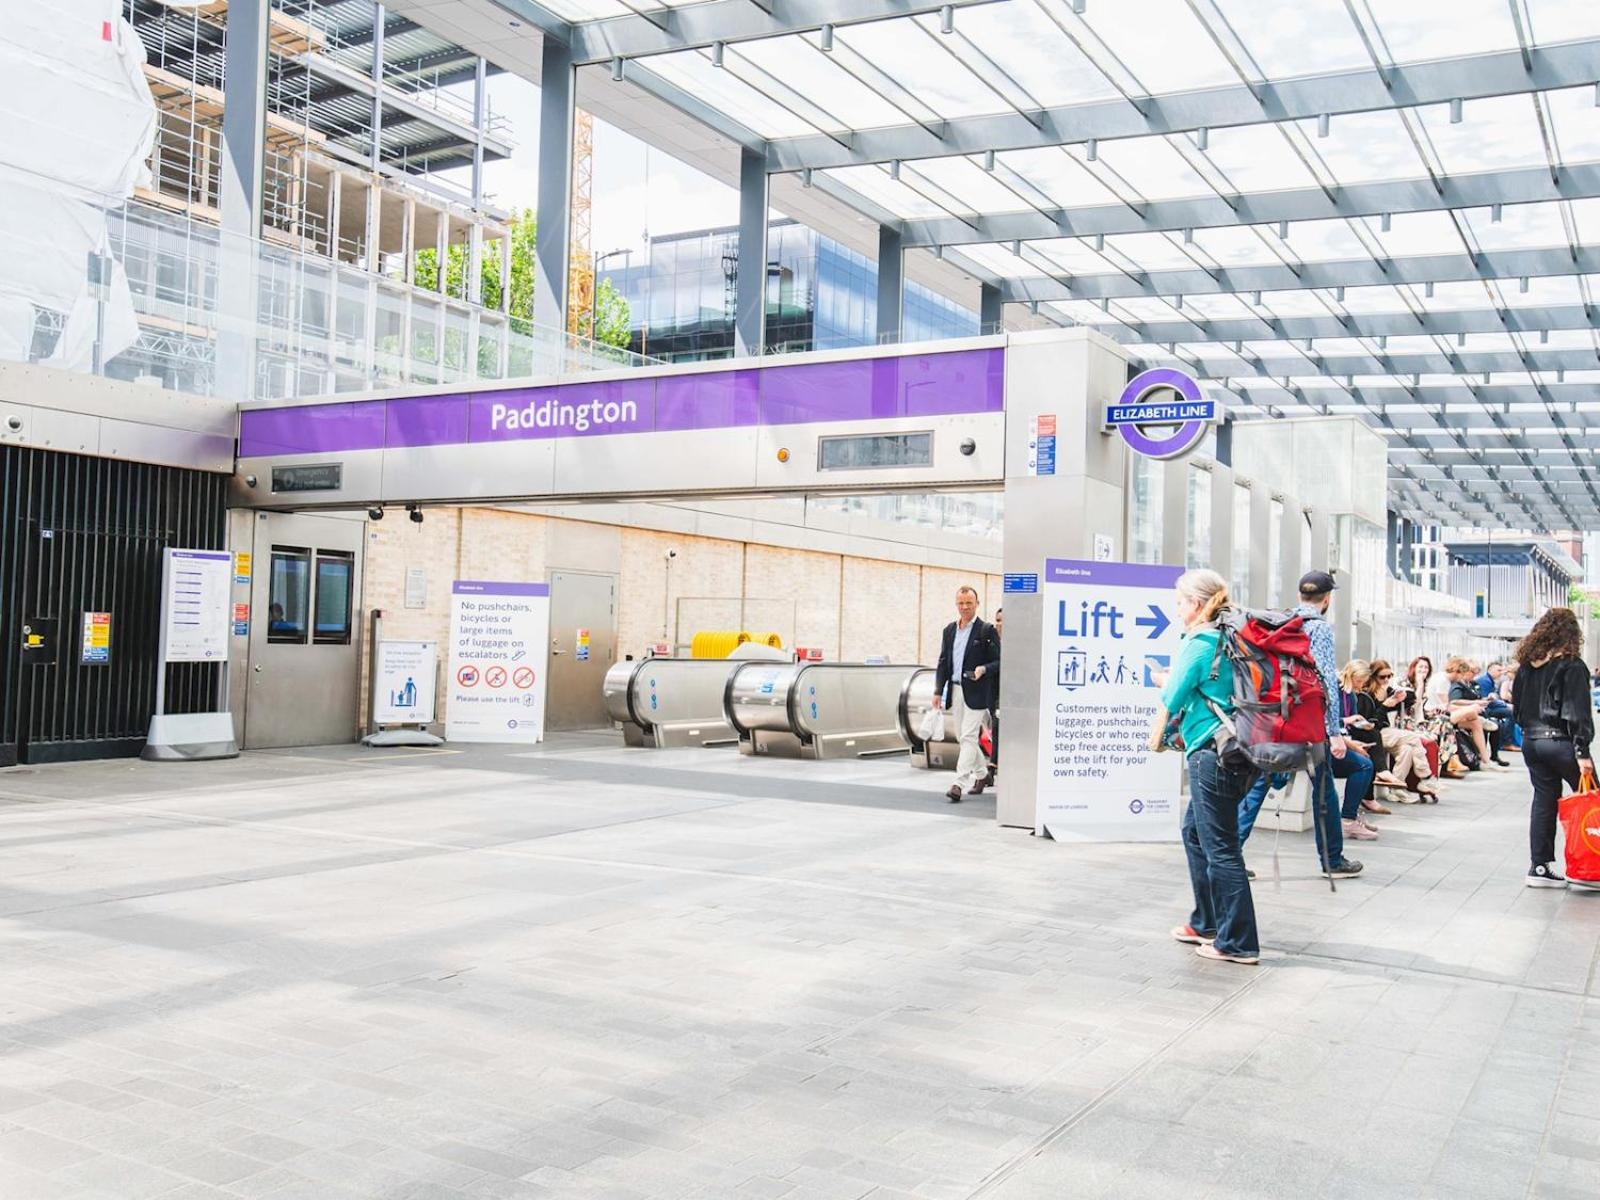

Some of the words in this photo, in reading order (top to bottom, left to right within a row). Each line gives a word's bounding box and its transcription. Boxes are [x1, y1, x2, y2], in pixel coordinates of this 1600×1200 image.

[491, 399, 637, 431] Paddington
[1113, 406, 1176, 420] ELIZABETH
[1180, 405, 1208, 417] LINE
[1055, 567, 1080, 576] Elizabeth
[461, 601, 476, 610] No
[478, 602, 532, 613] pushchairs,
[460, 614, 499, 624] bicycles
[501, 615, 512, 623] or
[1058, 600, 1124, 639] Lift
[460, 626, 483, 636] large
[486, 627, 513, 635] items
[459, 638, 470, 647] of
[472, 639, 509, 649] luggage
[511, 640, 524, 648] on
[458, 650, 508, 659] escalators
[456, 694, 479, 703] Please
[509, 696, 520, 704] lift
[1056, 703, 1108, 714] Customers
[1110, 704, 1132, 714] with
[1134, 705, 1157, 717] large
[1097, 717, 1150, 728] pushchairs,
[1055, 729, 1094, 741] bicycles
[1096, 731, 1106, 739] or
[1108, 730, 1129, 739] who
[1054, 743, 1076, 754] step
[1078, 741, 1098, 752] free
[1054, 756, 1071, 764] use
[1074, 754, 1090, 764] the
[1093, 754, 1107, 764] lift
[1109, 755, 1123, 764] for
[1126, 756, 1147, 766] your
[1053, 769, 1074, 777] own
[1077, 767, 1109, 779] safety.
